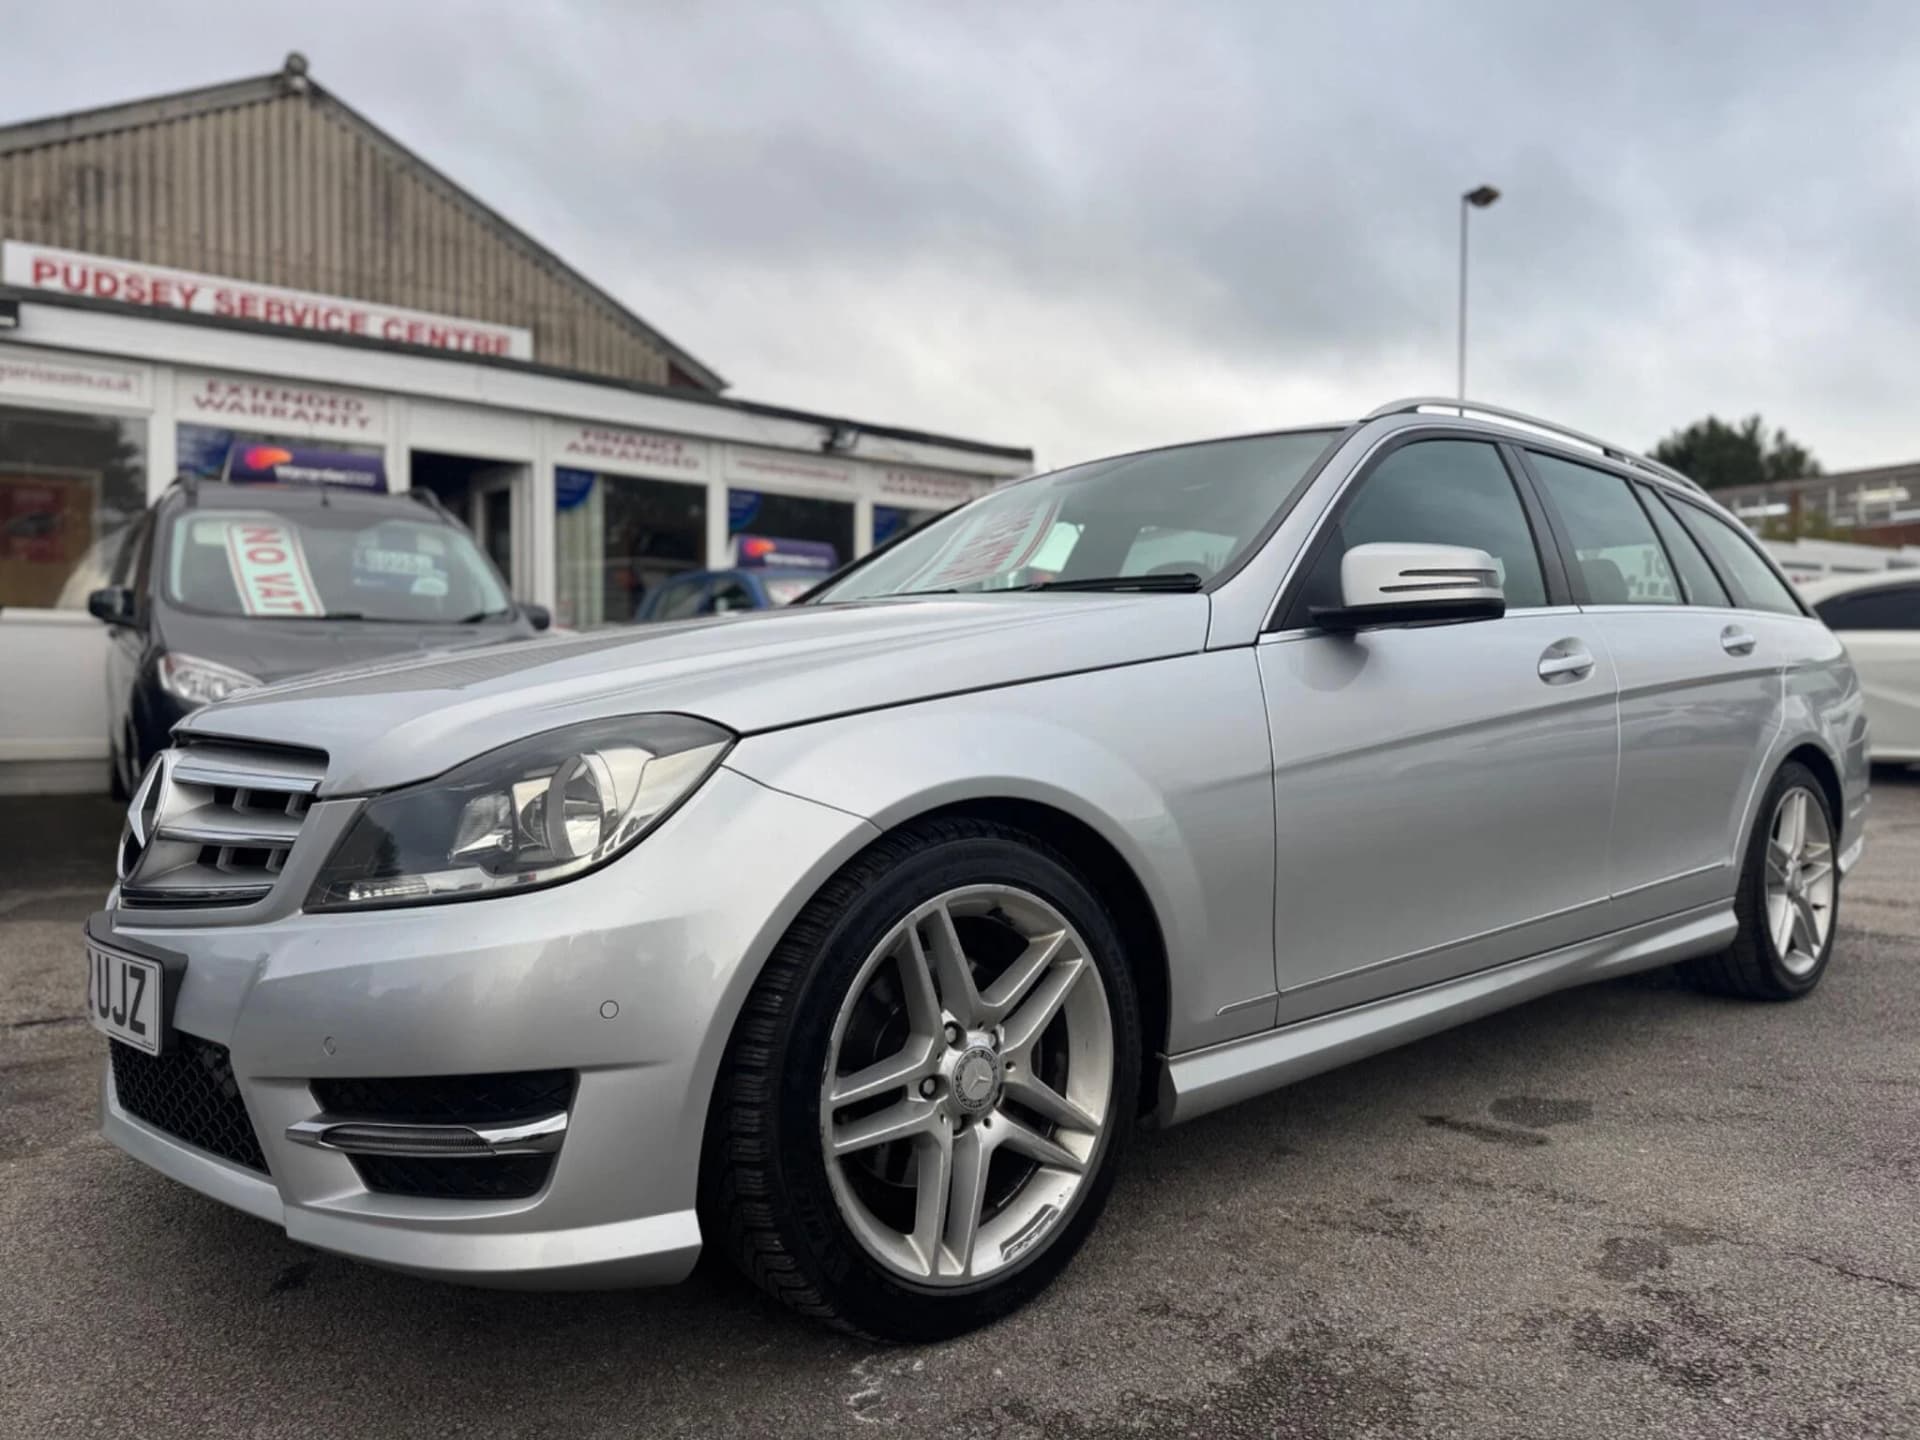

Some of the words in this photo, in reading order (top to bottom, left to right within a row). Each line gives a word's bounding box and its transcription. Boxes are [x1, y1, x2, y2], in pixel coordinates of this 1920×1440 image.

[32, 258, 198, 312] PUDSEY
[214, 288, 367, 335] SERVICE
[383, 316, 511, 356] CENTRE
[193, 393, 371, 429] WARRANTY
[206, 380, 364, 412] EXTENDED
[242, 526, 288, 565] NO
[253, 572, 306, 614] VAT
[97, 952, 147, 1036] UJZ
